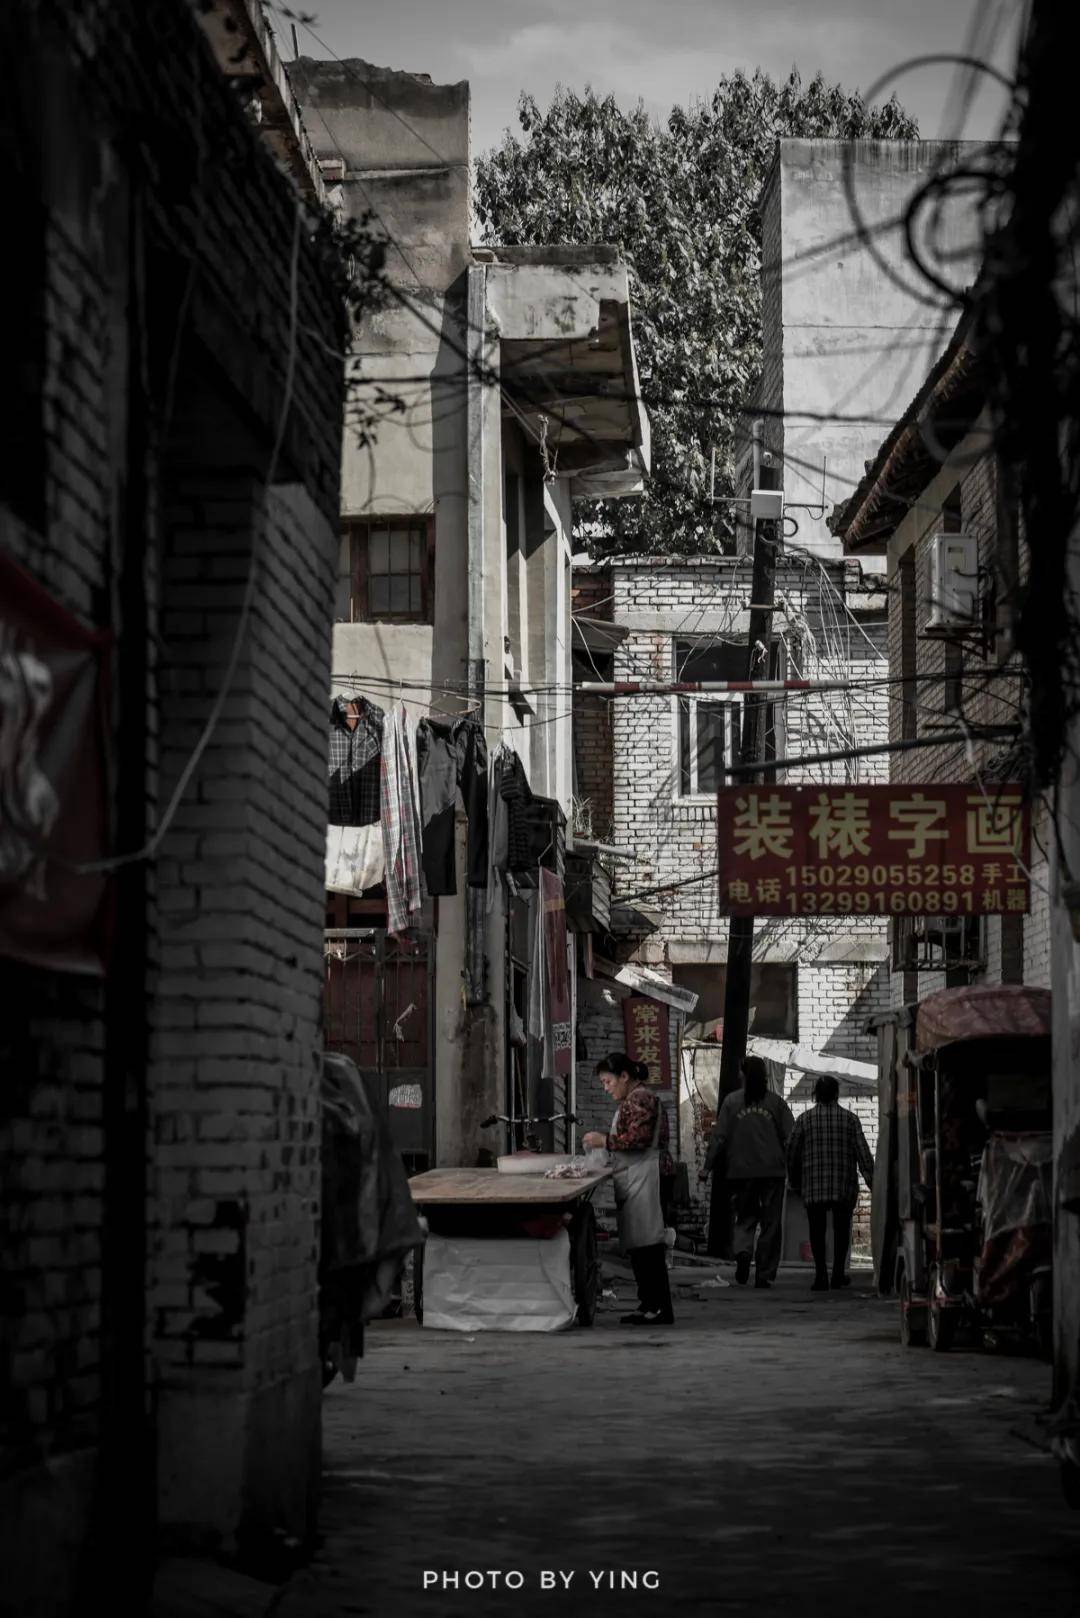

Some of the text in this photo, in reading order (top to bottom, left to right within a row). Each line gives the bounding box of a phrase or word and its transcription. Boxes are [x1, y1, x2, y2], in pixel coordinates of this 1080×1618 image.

[732, 792, 1023, 860] 装裱字画
[785, 864, 976, 887] 15029055258
[981, 862, 1027, 885] 手工
[728, 877, 782, 905] 电话
[785, 890, 975, 913] 13299160891
[982, 888, 1027, 912] 机器
